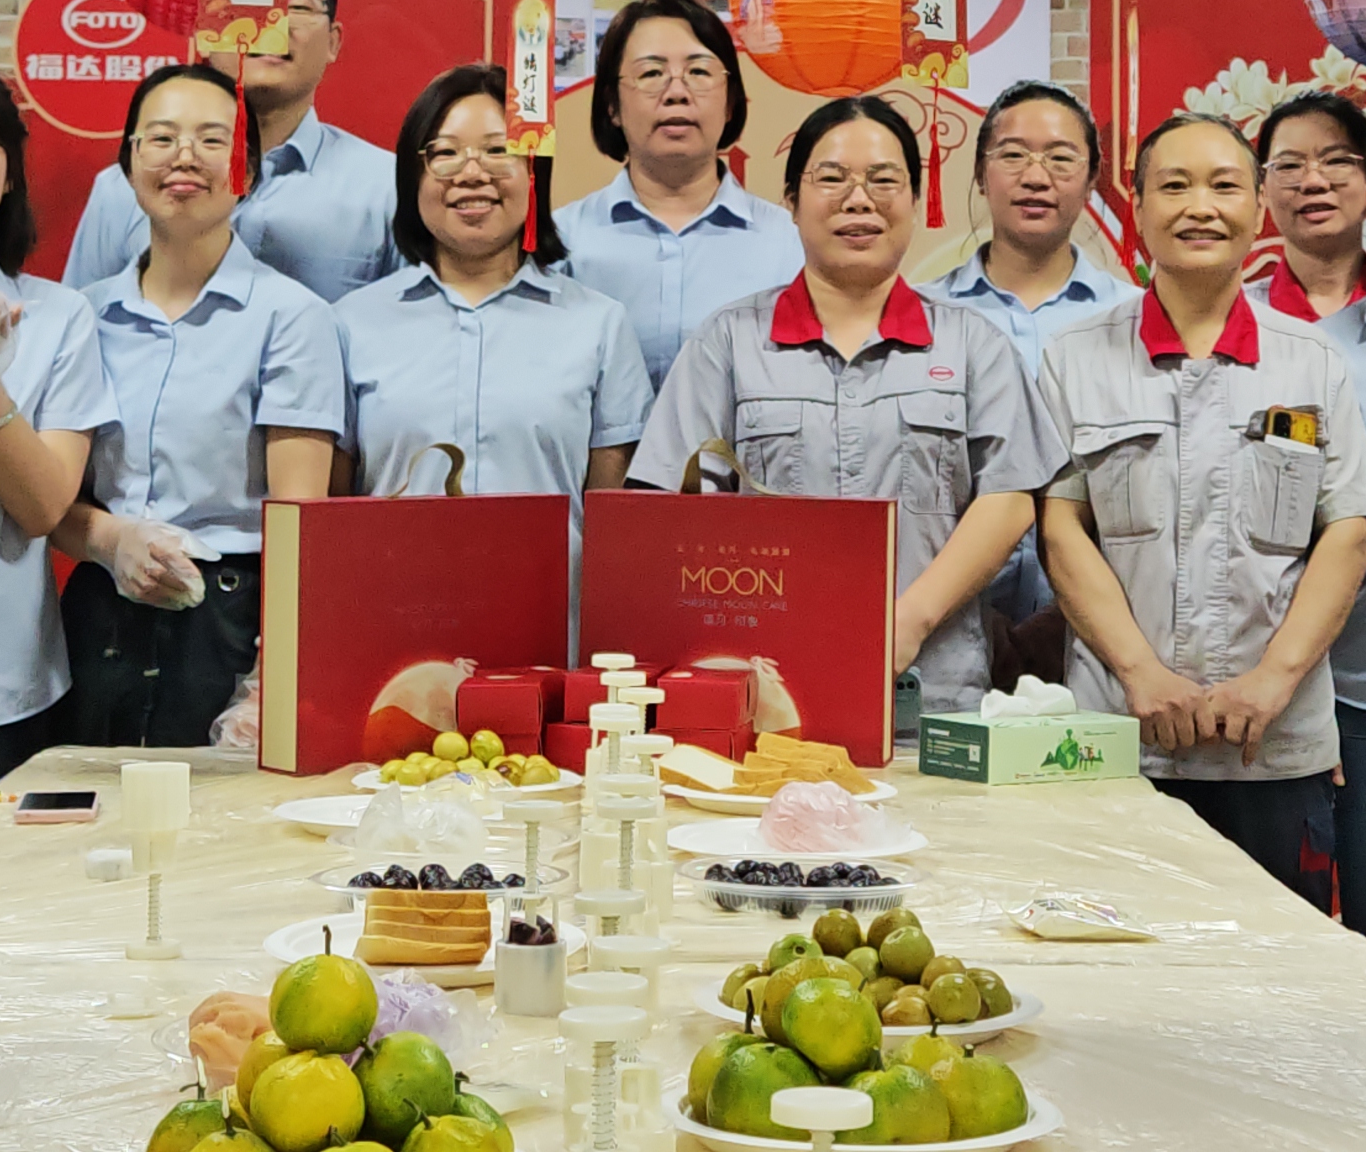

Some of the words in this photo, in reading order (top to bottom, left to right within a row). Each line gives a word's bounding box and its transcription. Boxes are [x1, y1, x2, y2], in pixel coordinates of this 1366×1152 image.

[25, 54, 181, 82] 福达股份
[681, 566, 784, 596] MOON
